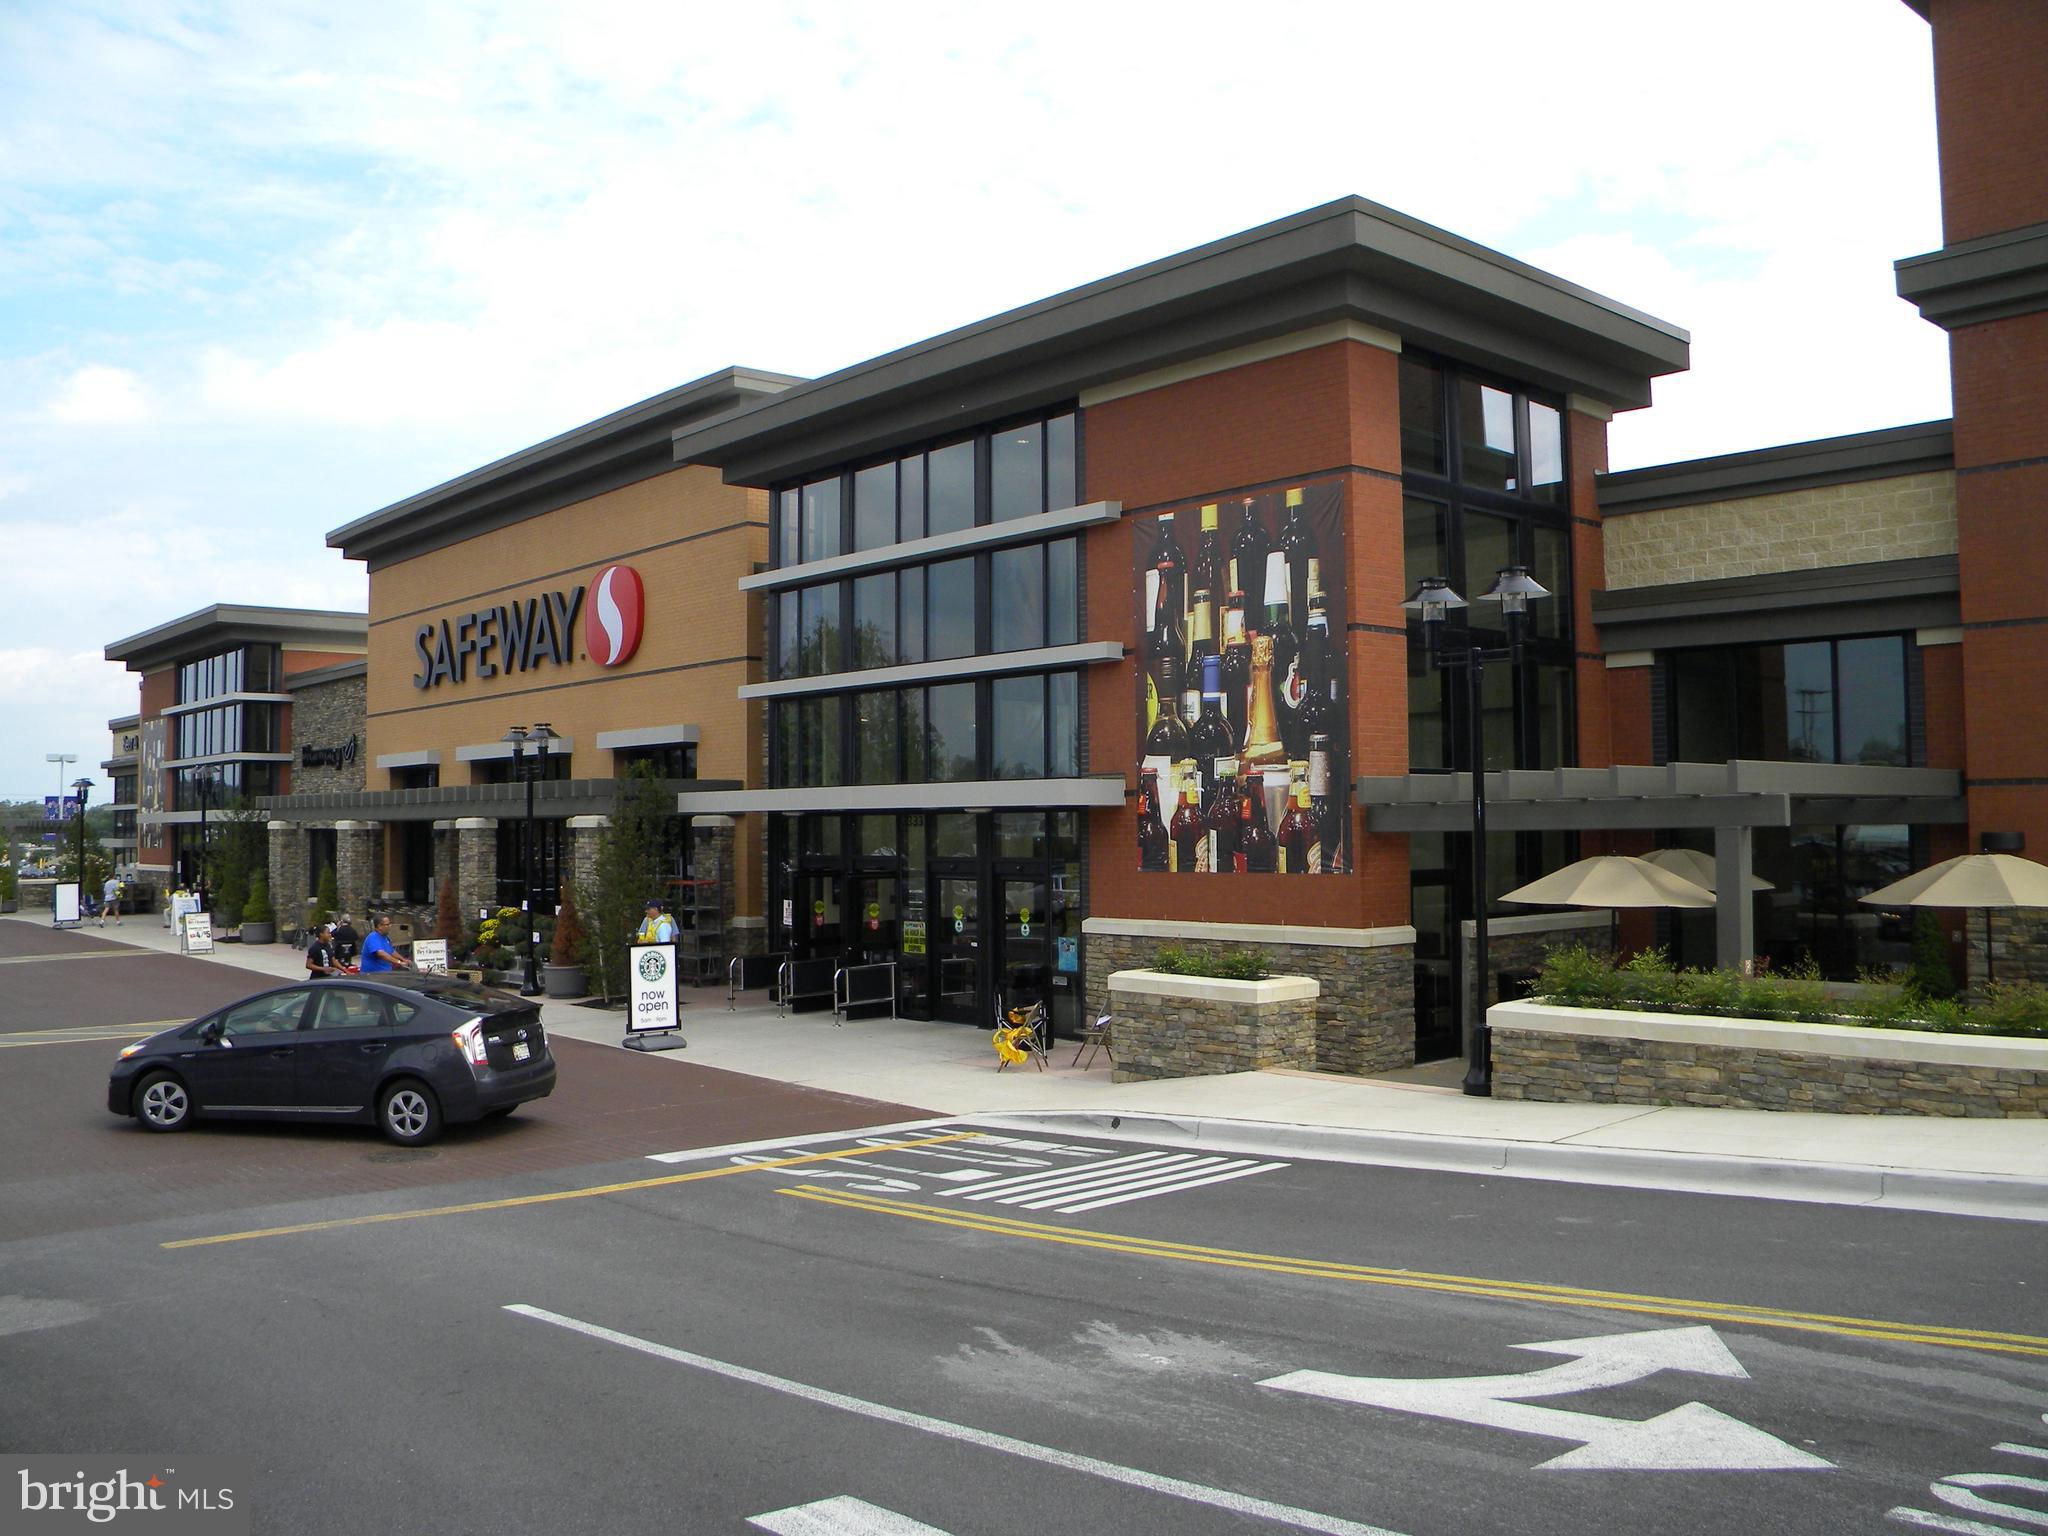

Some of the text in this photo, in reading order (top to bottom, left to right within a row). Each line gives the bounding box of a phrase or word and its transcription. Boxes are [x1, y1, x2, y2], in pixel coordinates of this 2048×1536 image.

[413, 586, 585, 689] SAFEWAY
[641, 991, 665, 1000] now
[638, 1001, 669, 1014] open
